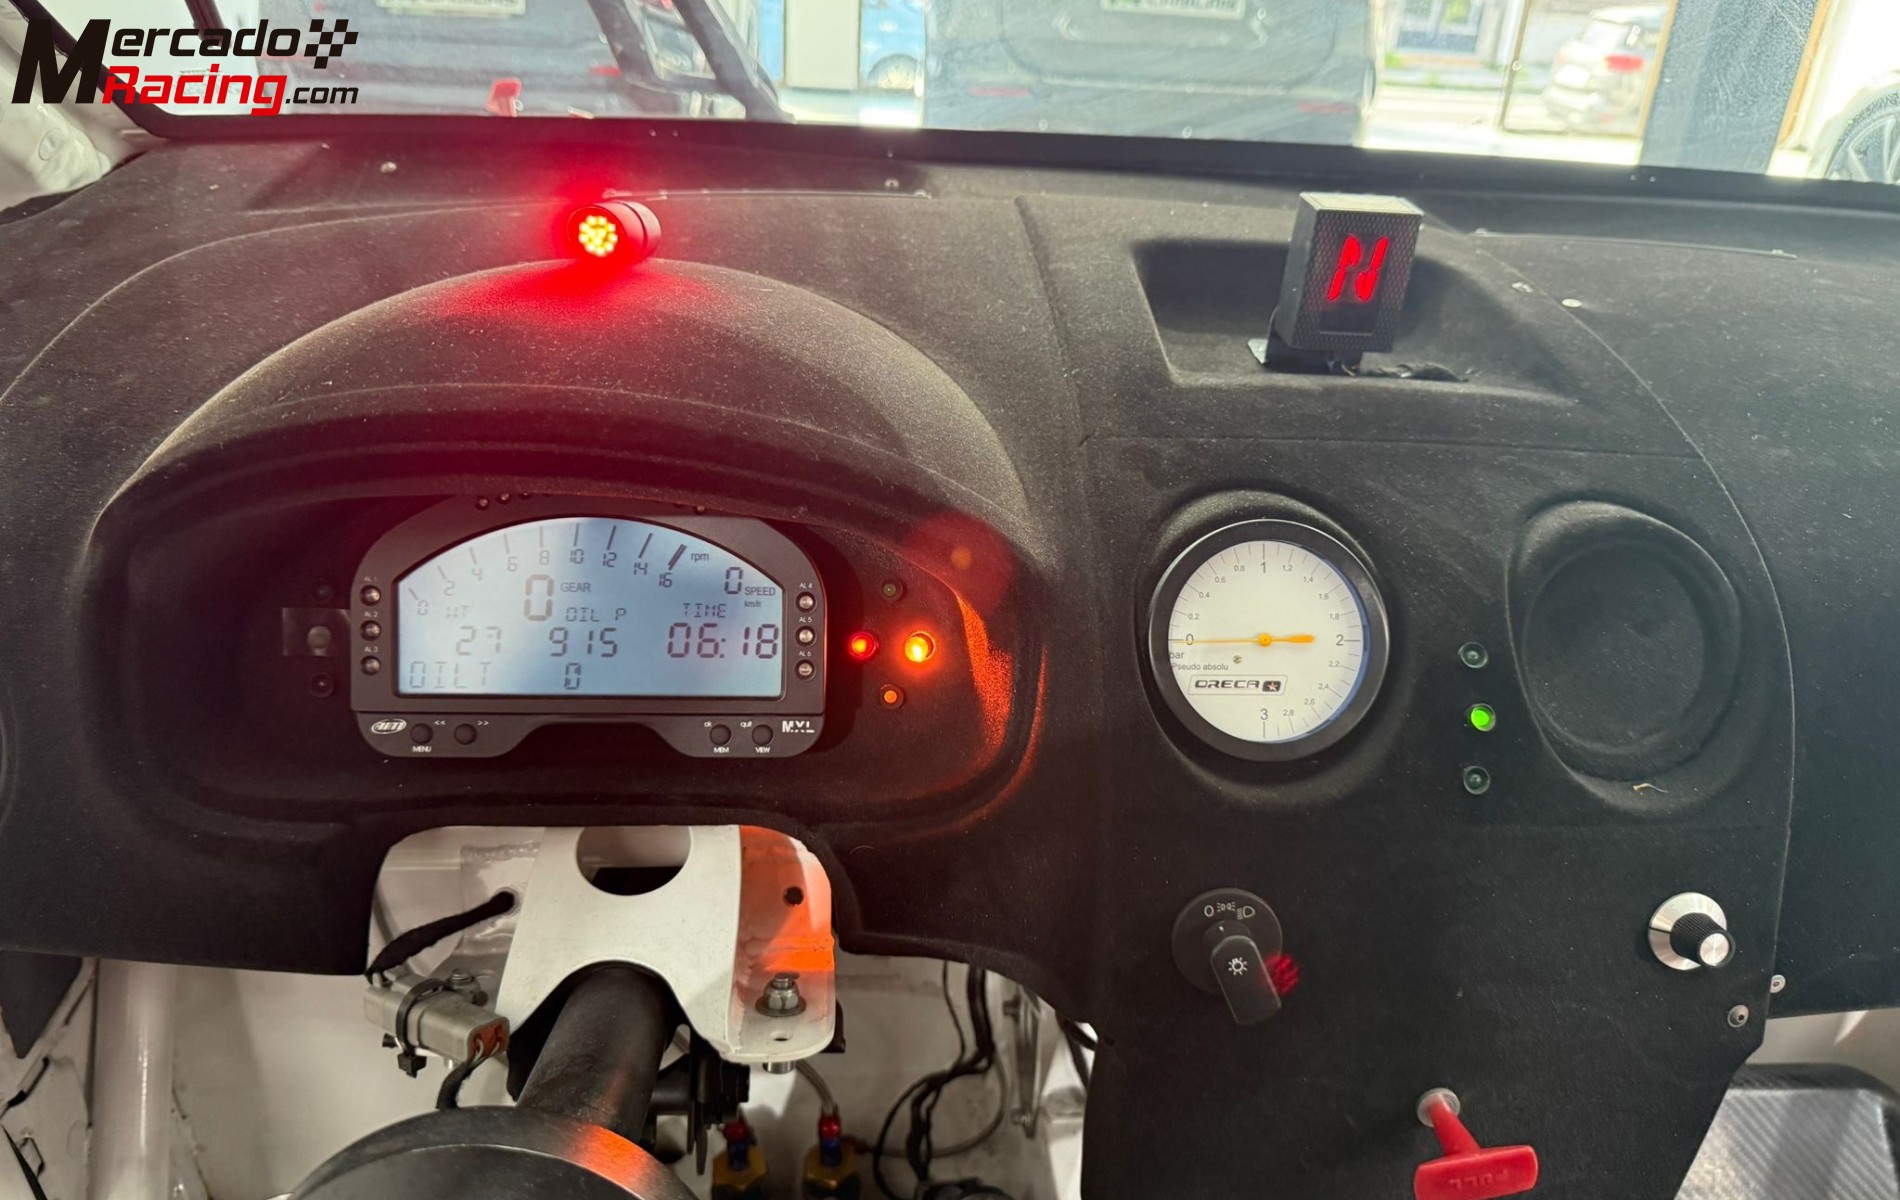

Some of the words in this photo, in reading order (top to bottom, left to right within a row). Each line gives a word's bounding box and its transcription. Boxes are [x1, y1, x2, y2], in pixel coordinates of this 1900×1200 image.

[507, 556, 518, 572] 6
[539, 549, 551, 565] 8
[570, 549, 584, 564] 10
[602, 552, 617, 567] 12
[690, 553, 709, 562] rpm
[472, 568, 482, 581] 4
[633, 562, 648, 576] 14
[1259, 561, 1266, 574] 1
[444, 580, 455, 596] 2
[560, 582, 591, 593] GEAR
[659, 573, 673, 588] 16
[724, 567, 743, 595] 0
[524, 574, 555, 621] 0
[744, 587, 776, 597] SPEED
[566, 607, 600, 622] OIL
[615, 607, 627, 621] P
[683, 603, 728, 618] TIME
[455, 625, 503, 656] 27
[549, 627, 618, 658] 915
[667, 622, 779, 659] 06:18
[1185, 633, 1195, 646] 0
[1335, 633, 1344, 646] 2
[1171, 662, 1201, 671] Pseudo
[1202, 662, 1229, 671] absolu
[1194, 679, 1260, 689] ORECA
[1259, 708, 1269, 721] 3
[782, 720, 815, 733] MXL
[1448, 1169, 1509, 1192] PULL
